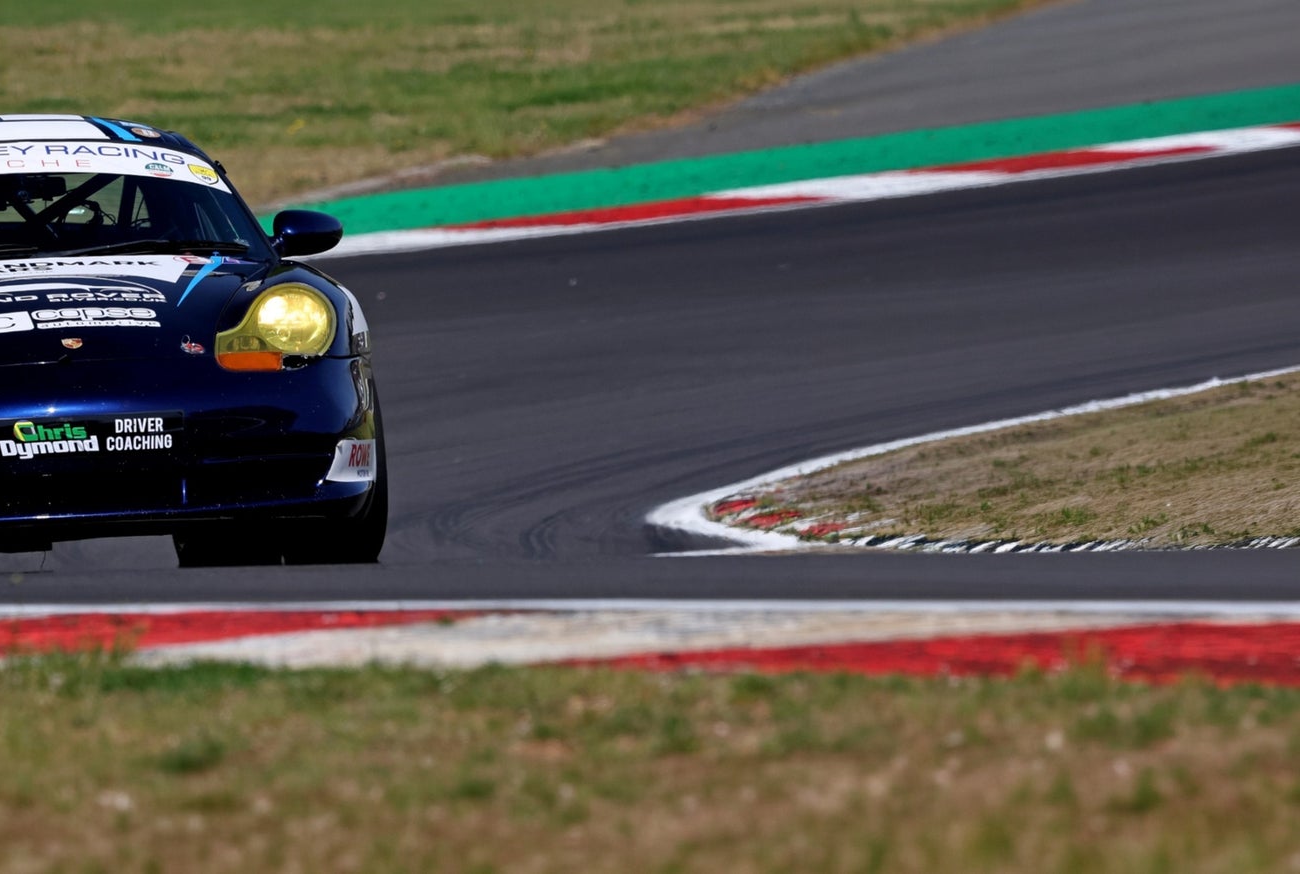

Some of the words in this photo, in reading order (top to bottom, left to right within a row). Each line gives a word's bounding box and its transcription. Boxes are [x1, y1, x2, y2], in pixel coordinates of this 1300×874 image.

[45, 145, 186, 165] RACING
[46, 292, 166, 300] ROVER
[32, 308, 156, 321] copse
[37, 320, 161, 329] automotive
[114, 417, 164, 434] DRIVER
[0, 435, 100, 459] Dymond
[106, 434, 173, 451] COACHING
